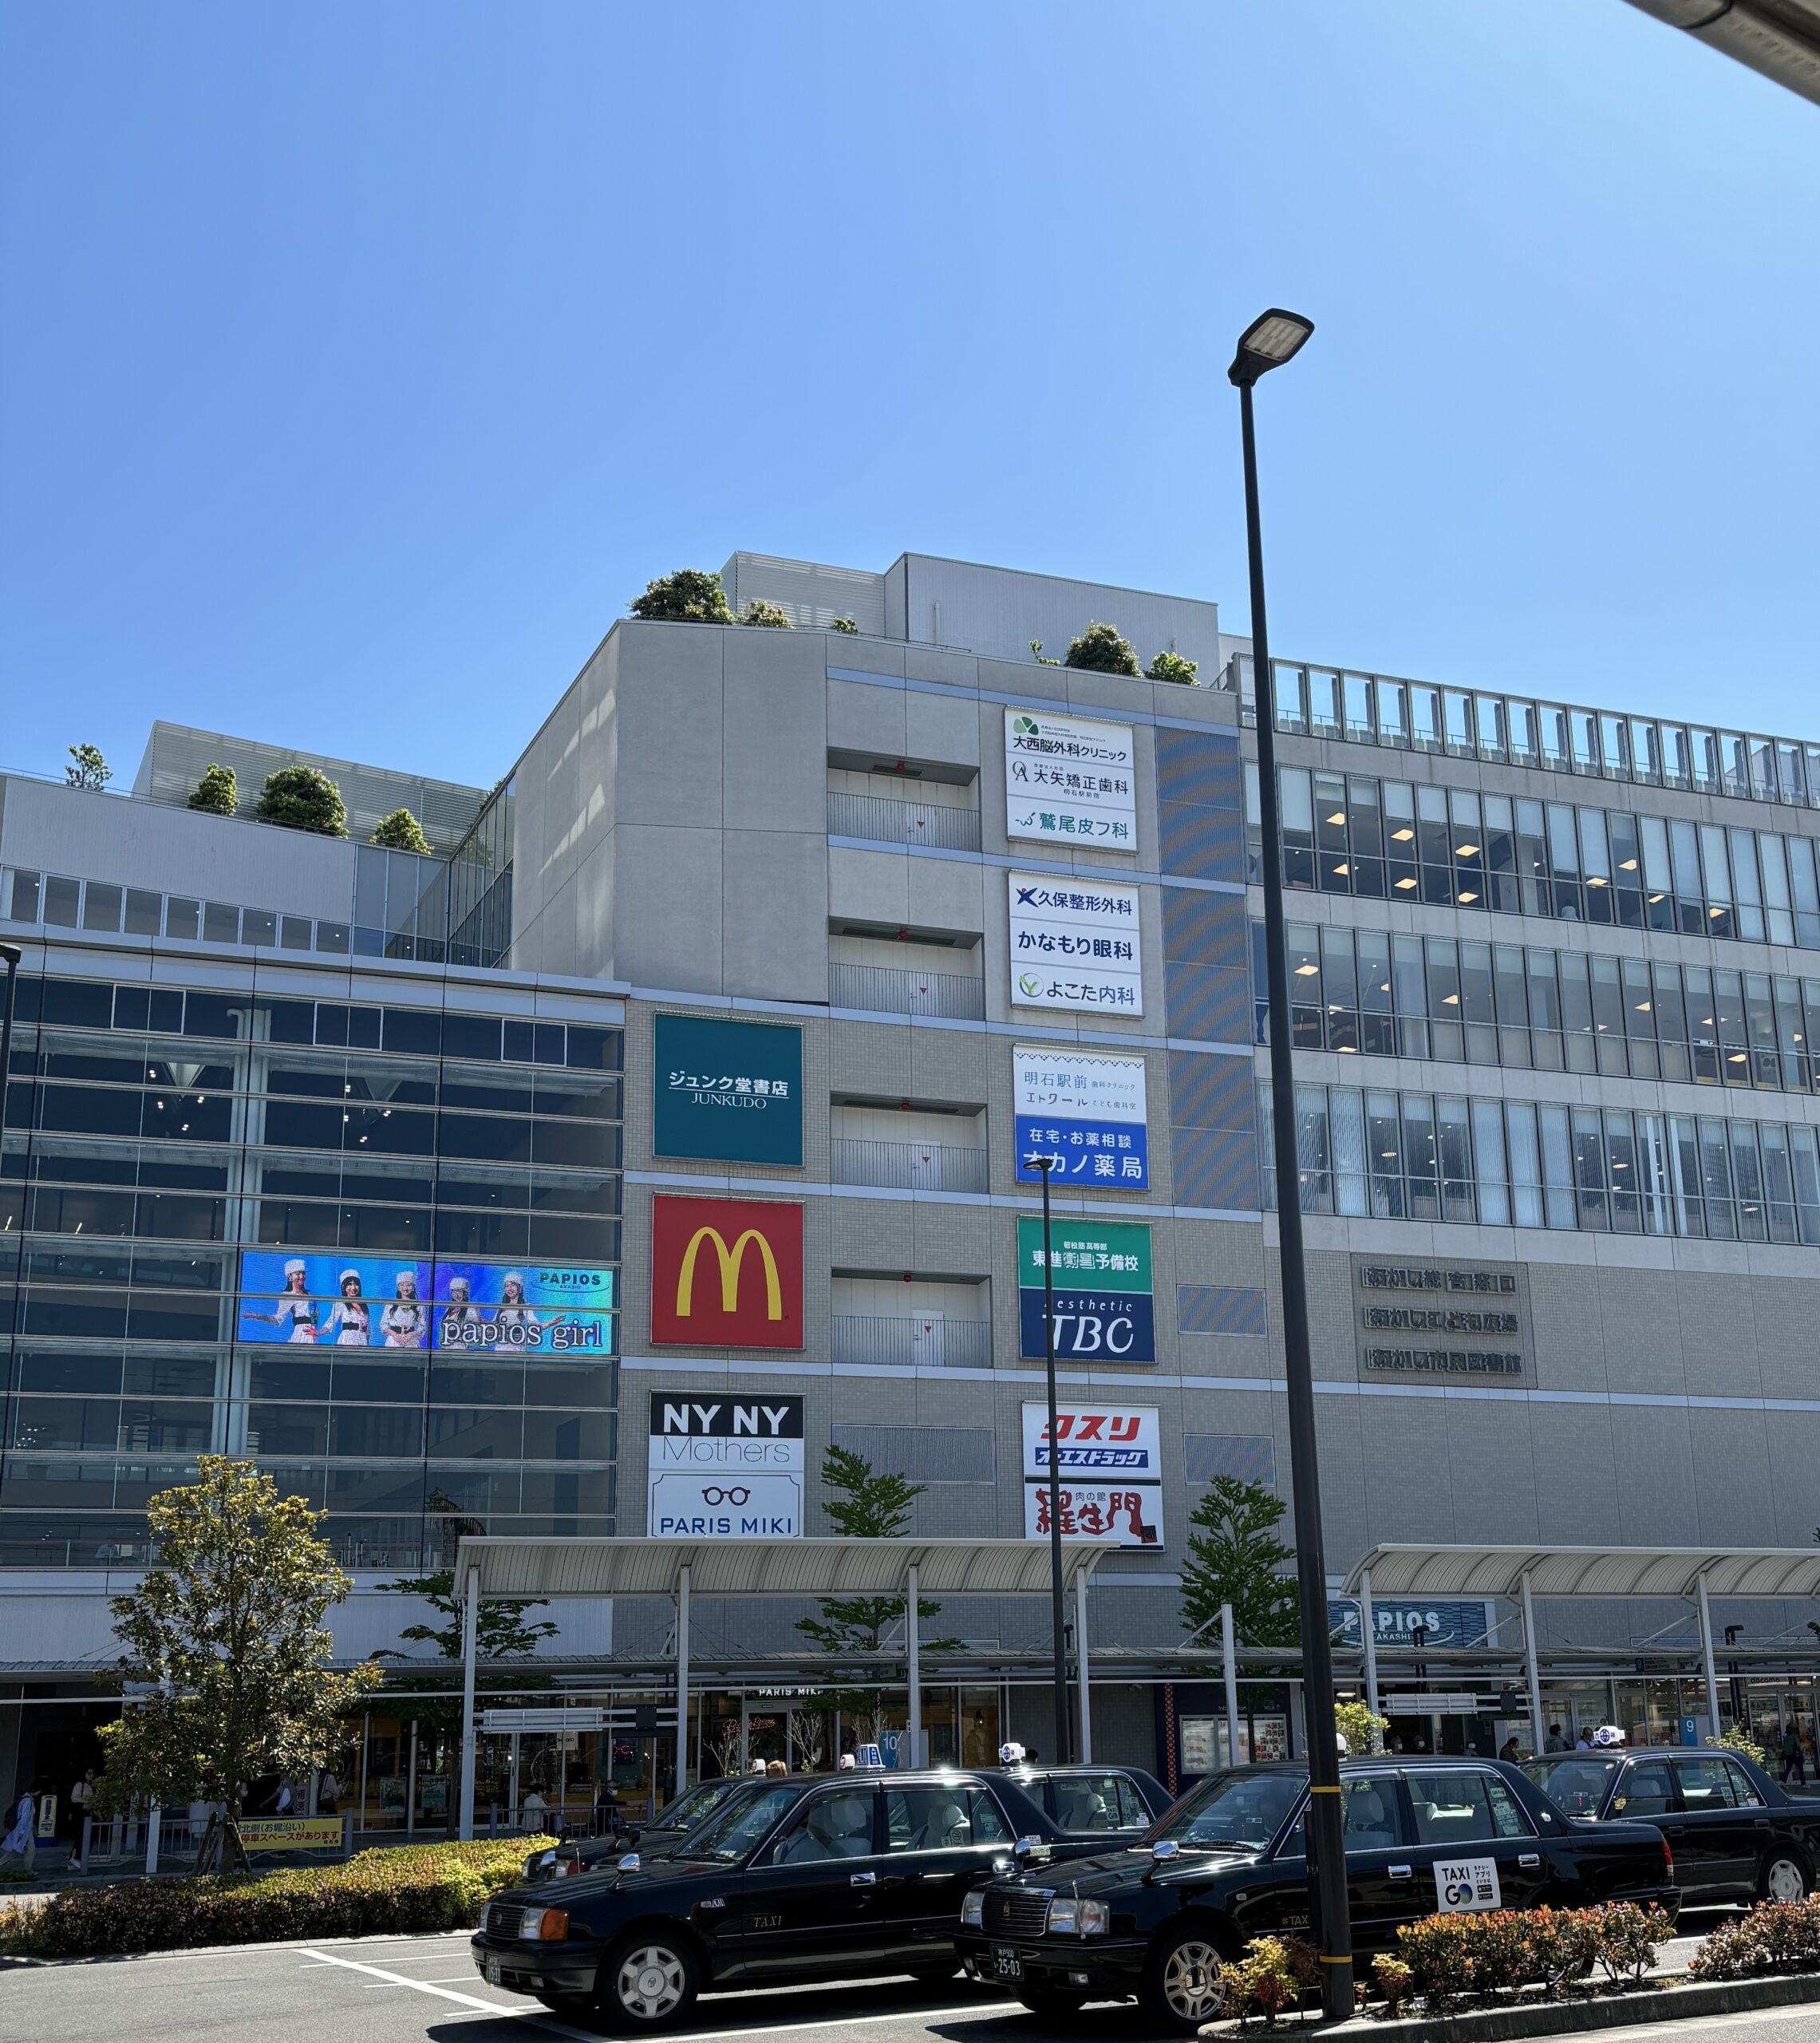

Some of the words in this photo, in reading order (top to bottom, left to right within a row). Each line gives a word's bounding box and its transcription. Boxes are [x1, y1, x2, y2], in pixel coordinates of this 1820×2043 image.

[1013, 736, 1126, 761] 大西脳外科クリニック
[1034, 769, 1128, 795] 大矢矯正歯科
[1064, 788, 1100, 799] 明石駅前院
[1040, 812, 1129, 840] 鷲尾皮フ科
[1038, 890, 1132, 916] 久保整形外科
[1018, 931, 1133, 961] かなもり眼科
[1047, 981, 1135, 1006] よこた内科
[669, 1070, 789, 1097] ジュンク堂書店
[1024, 1071, 1088, 1089] 明石駅前
[1092, 1081, 1135, 1092] 歯科クリニック
[691, 1093, 767, 1109] JUNKUDO
[1026, 1092, 1088, 1107] エトワール
[1029, 1128, 1131, 1149] 在宅・お薬相談
[539, 1272, 601, 1286] PAPIOS
[1044, 1298, 1133, 1312] esthetic
[441, 1315, 541, 1347] papios
[552, 1319, 602, 1349] girl
[1042, 1314, 1134, 1353] TBC
[664, 1403, 722, 1434] NY
[733, 1405, 790, 1435] NY
[1040, 1414, 1141, 1441] クスリ
[663, 1436, 790, 1463] Mothers
[1037, 1449, 1146, 1466] オエスドラッグ
[1076, 1492, 1107, 1502] 肉の館
[661, 1518, 731, 1534] PARIS
[741, 1518, 792, 1534] MIKI
[1686, 1720, 1694, 1733] 9
[883, 1736, 898, 1750] 10
[1441, 1866, 1471, 1881] TAXI
[1445, 1883, 1473, 1906] GO
[754, 1915, 782, 1927] TAXI
[1289, 1915, 1310, 1926] TAX
